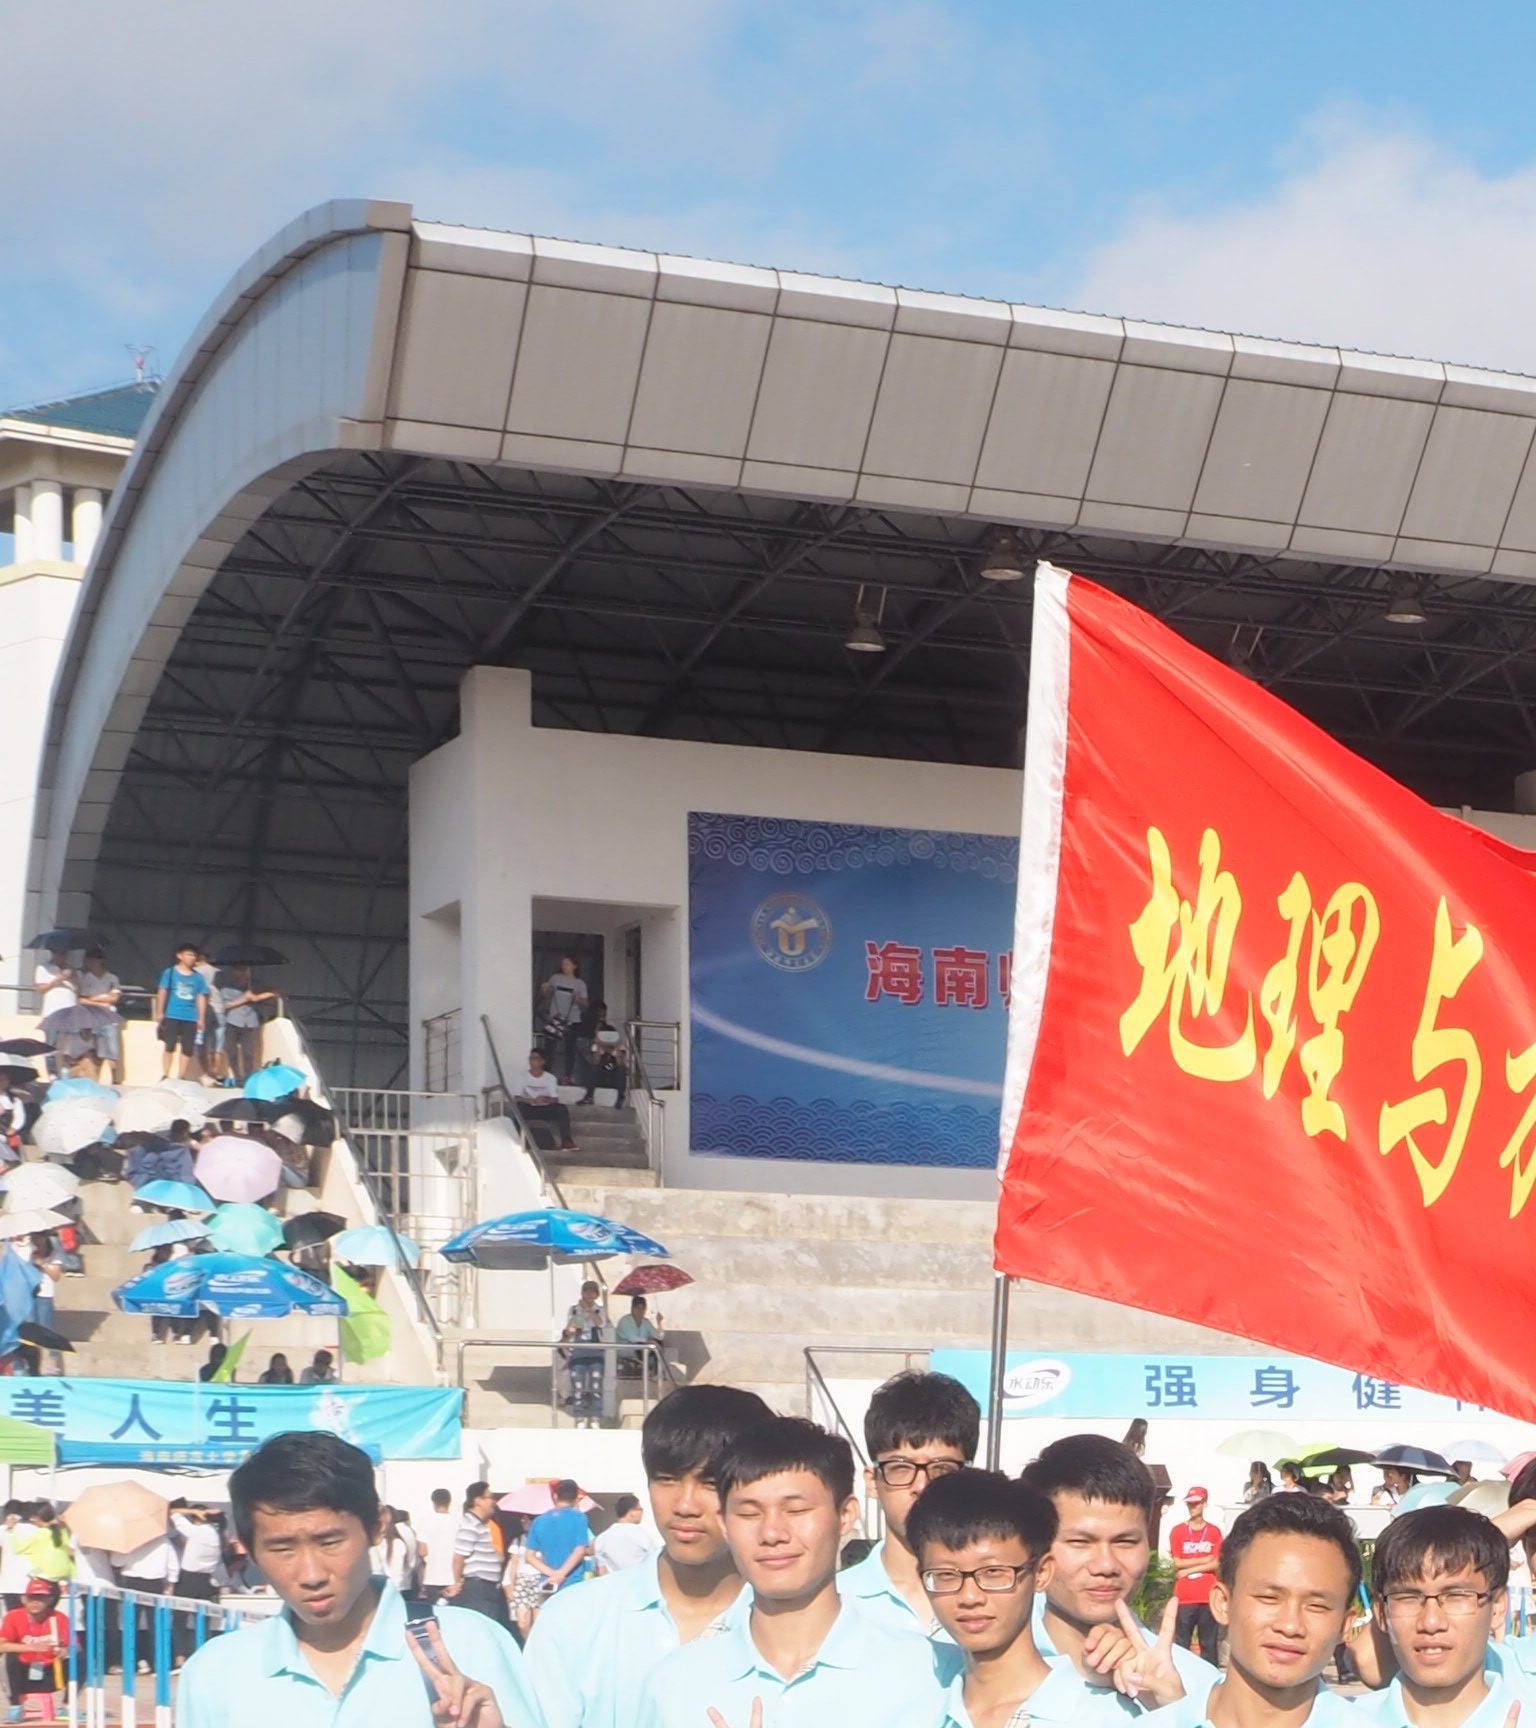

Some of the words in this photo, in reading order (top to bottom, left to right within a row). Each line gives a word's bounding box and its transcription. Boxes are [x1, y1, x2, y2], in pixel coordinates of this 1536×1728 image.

[865, 939, 1012, 1011] 海南
[1144, 1365, 1486, 1412] 强身健
